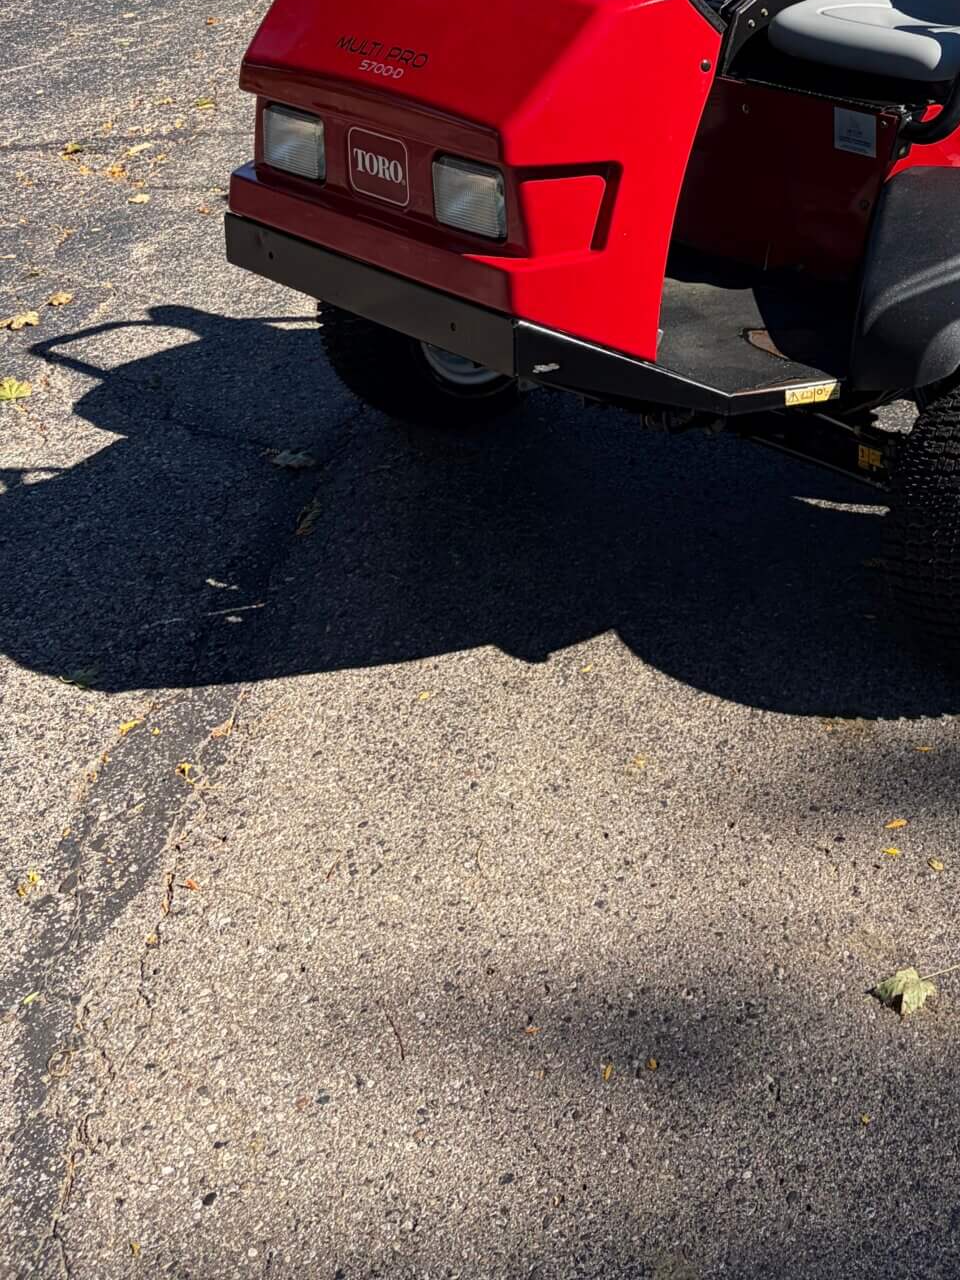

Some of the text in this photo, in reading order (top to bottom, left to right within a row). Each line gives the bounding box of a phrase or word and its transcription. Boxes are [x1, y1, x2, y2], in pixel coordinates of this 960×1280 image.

[336, 34, 429, 69] MULTI PRO
[353, 147, 403, 184] TORO
